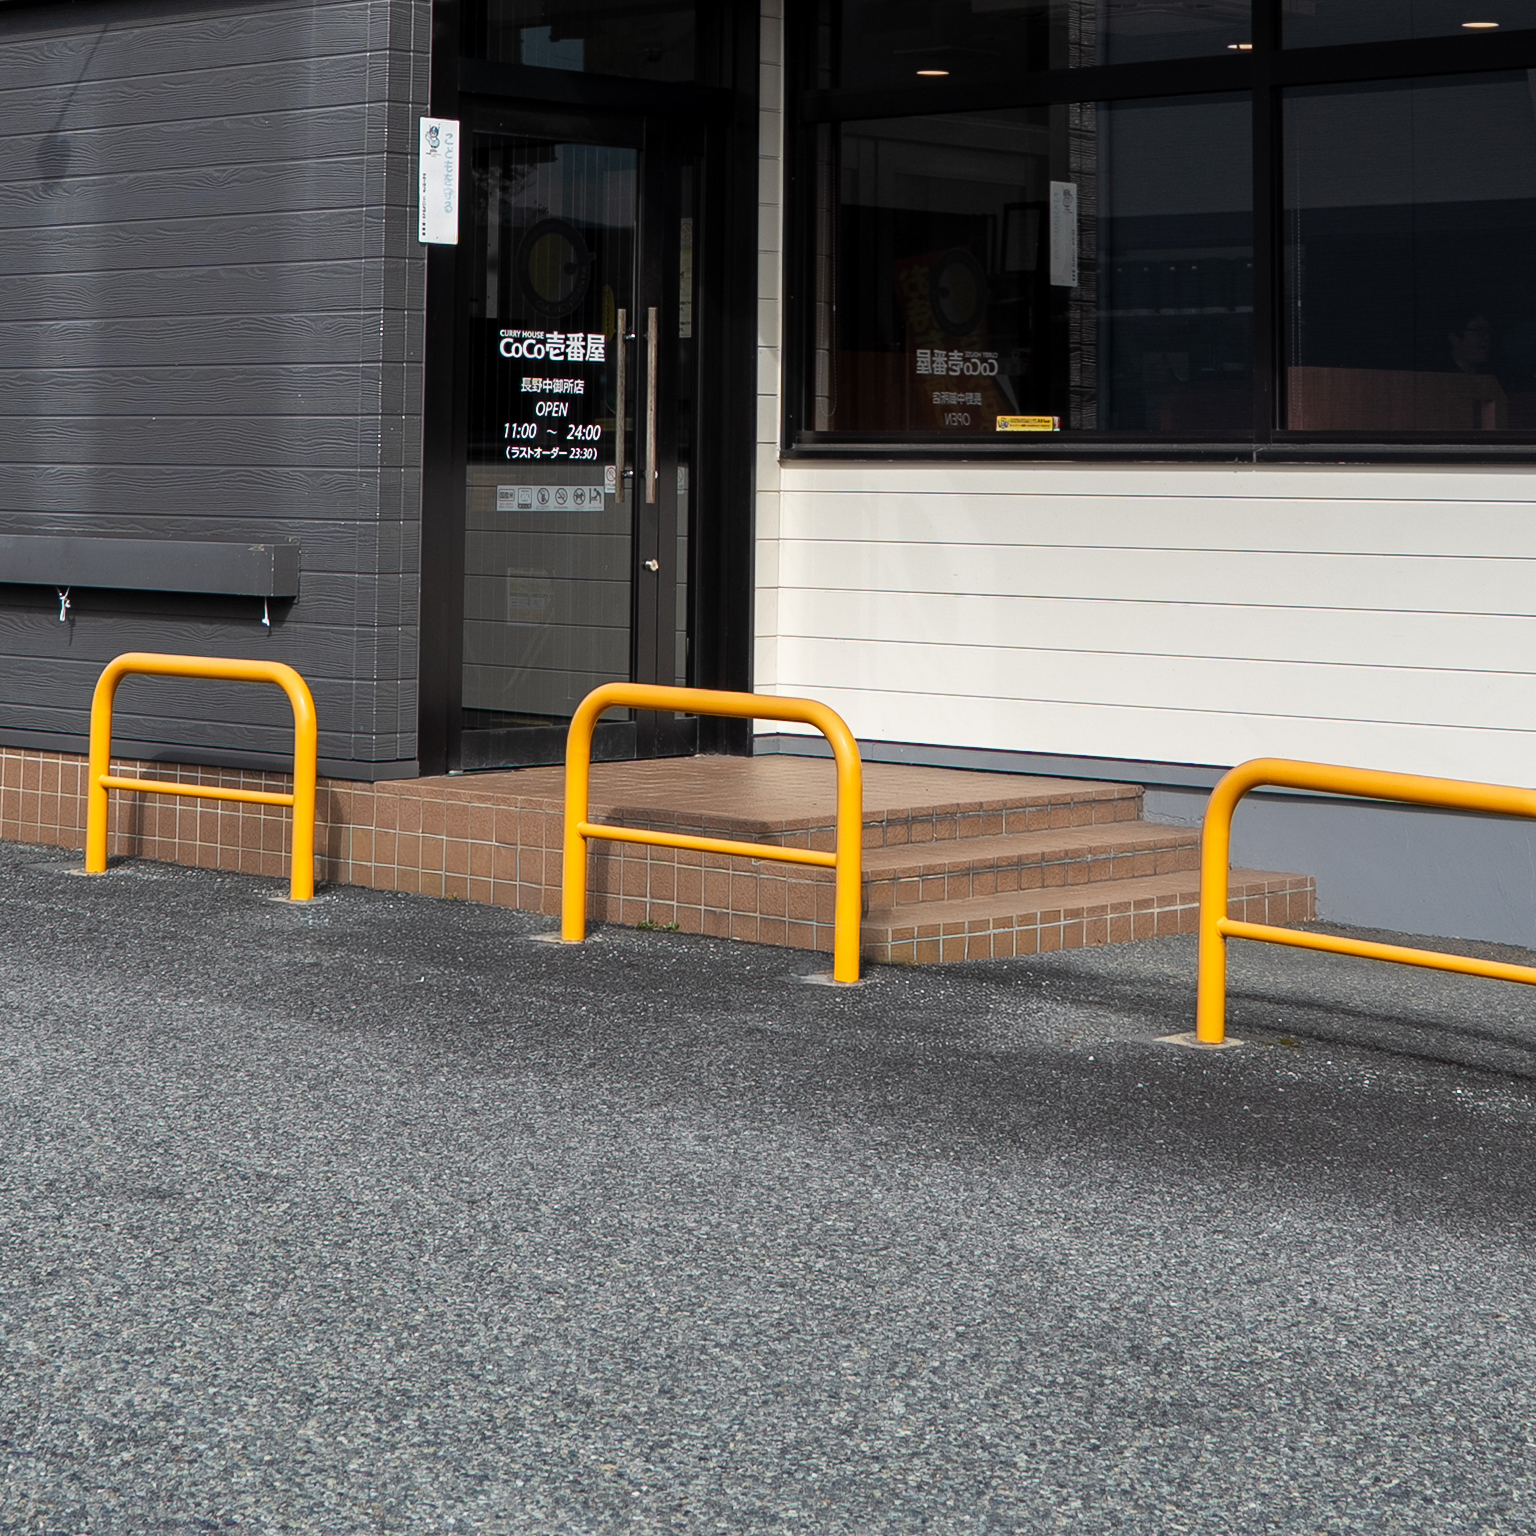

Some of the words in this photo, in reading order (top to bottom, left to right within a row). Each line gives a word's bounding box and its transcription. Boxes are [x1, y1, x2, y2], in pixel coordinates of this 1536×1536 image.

[499, 329, 522, 338] CURRY
[522, 330, 545, 340] HOUSE
[499, 331, 606, 362] CoCo壱番屋
[520, 377, 585, 395] 長野中御所店
[535, 401, 569, 417] OPEN
[504, 423, 538, 439] 11:00
[566, 424, 602, 441] 24:00
